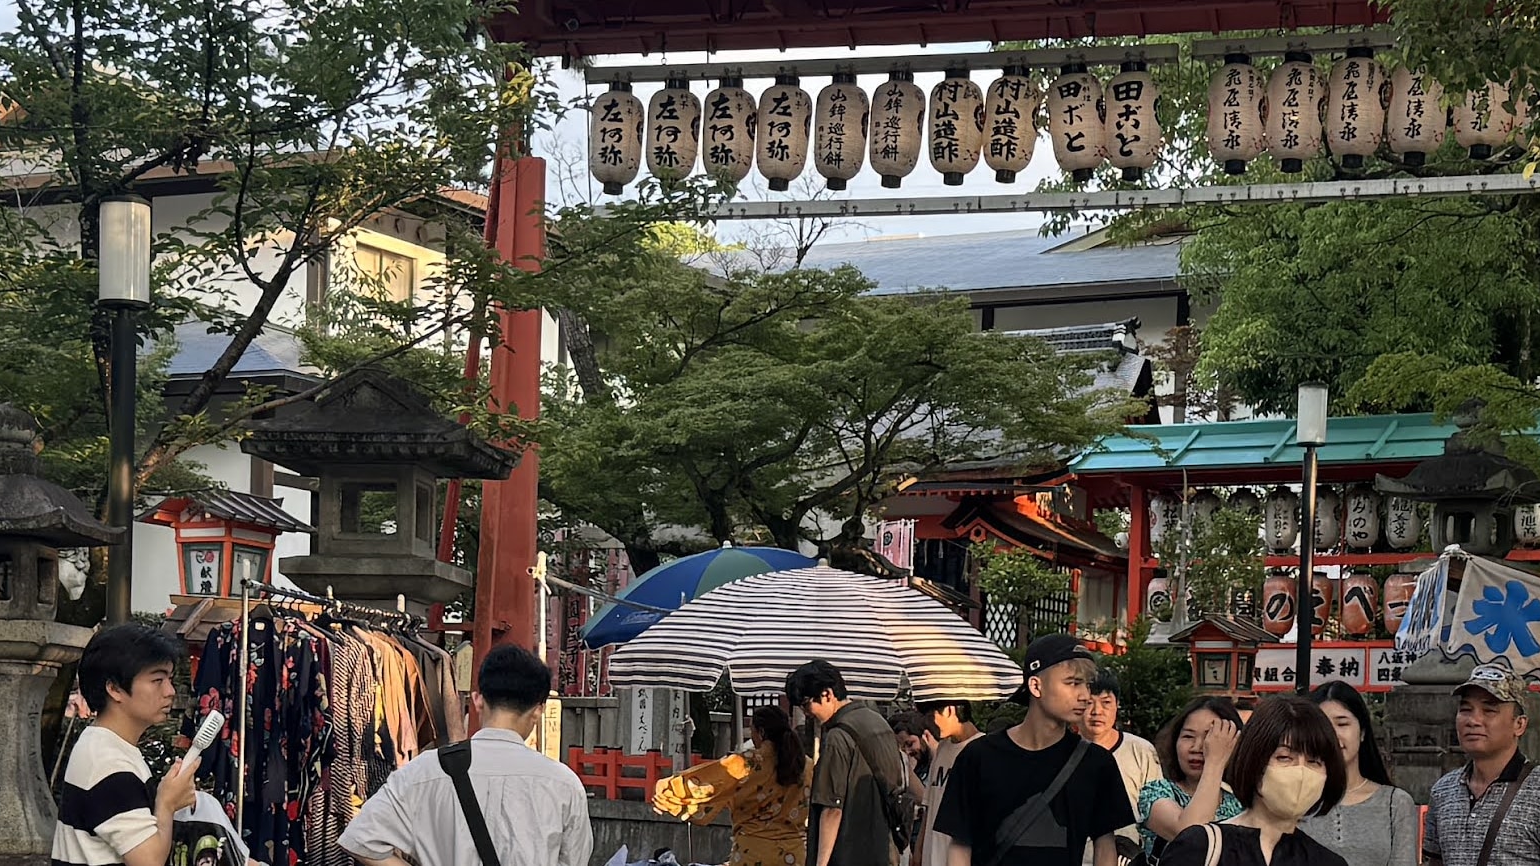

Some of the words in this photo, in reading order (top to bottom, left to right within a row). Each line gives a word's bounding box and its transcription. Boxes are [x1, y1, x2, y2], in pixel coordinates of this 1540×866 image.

[597, 98, 624, 166] 左阿弥
[652, 94, 682, 168] 左阿弥
[708, 92, 736, 166] 左阿弥
[765, 91, 793, 162] 左阿弥
[822, 88, 847, 169] 山鉾巡行餅
[879, 83, 904, 162] 山鉾巡行餅
[933, 81, 963, 163] 村山造酢
[989, 77, 1026, 161] 村山造酢
[1223, 68, 1243, 150] 亀屋清永
[1339, 61, 1361, 141] 亀屋清永
[1315, 655, 1360, 678] 奉納
